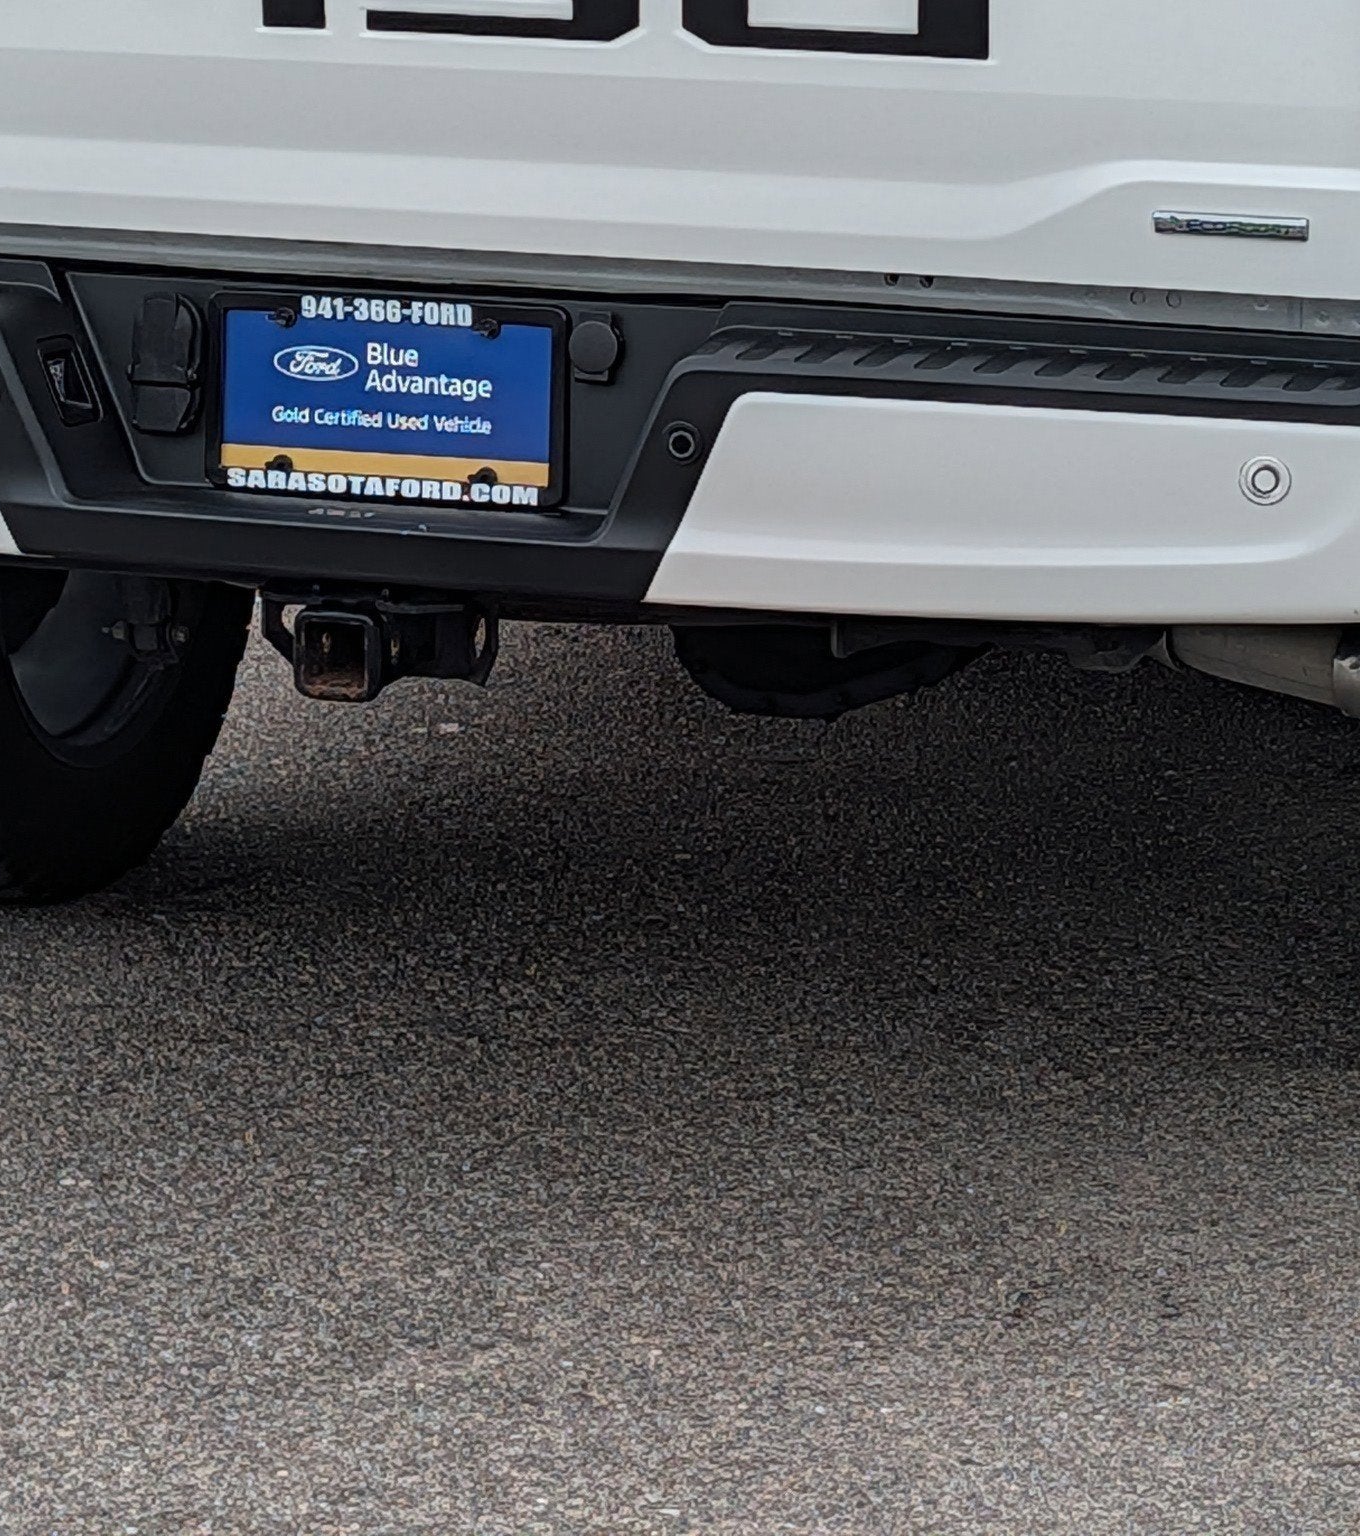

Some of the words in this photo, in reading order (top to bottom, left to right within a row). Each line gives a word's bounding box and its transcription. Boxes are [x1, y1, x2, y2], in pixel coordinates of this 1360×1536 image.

[301, 295, 473, 326] 941-366-FORD
[289, 350, 342, 376] Ford
[366, 343, 418, 367] Blue
[365, 369, 493, 402] Advantage
[272, 405, 310, 425] Gold
[314, 408, 382, 429] Certified
[387, 412, 428, 432] Used
[433, 415, 492, 435] Vehicle
[227, 467, 538, 507] SARASOTAFORD.COM
